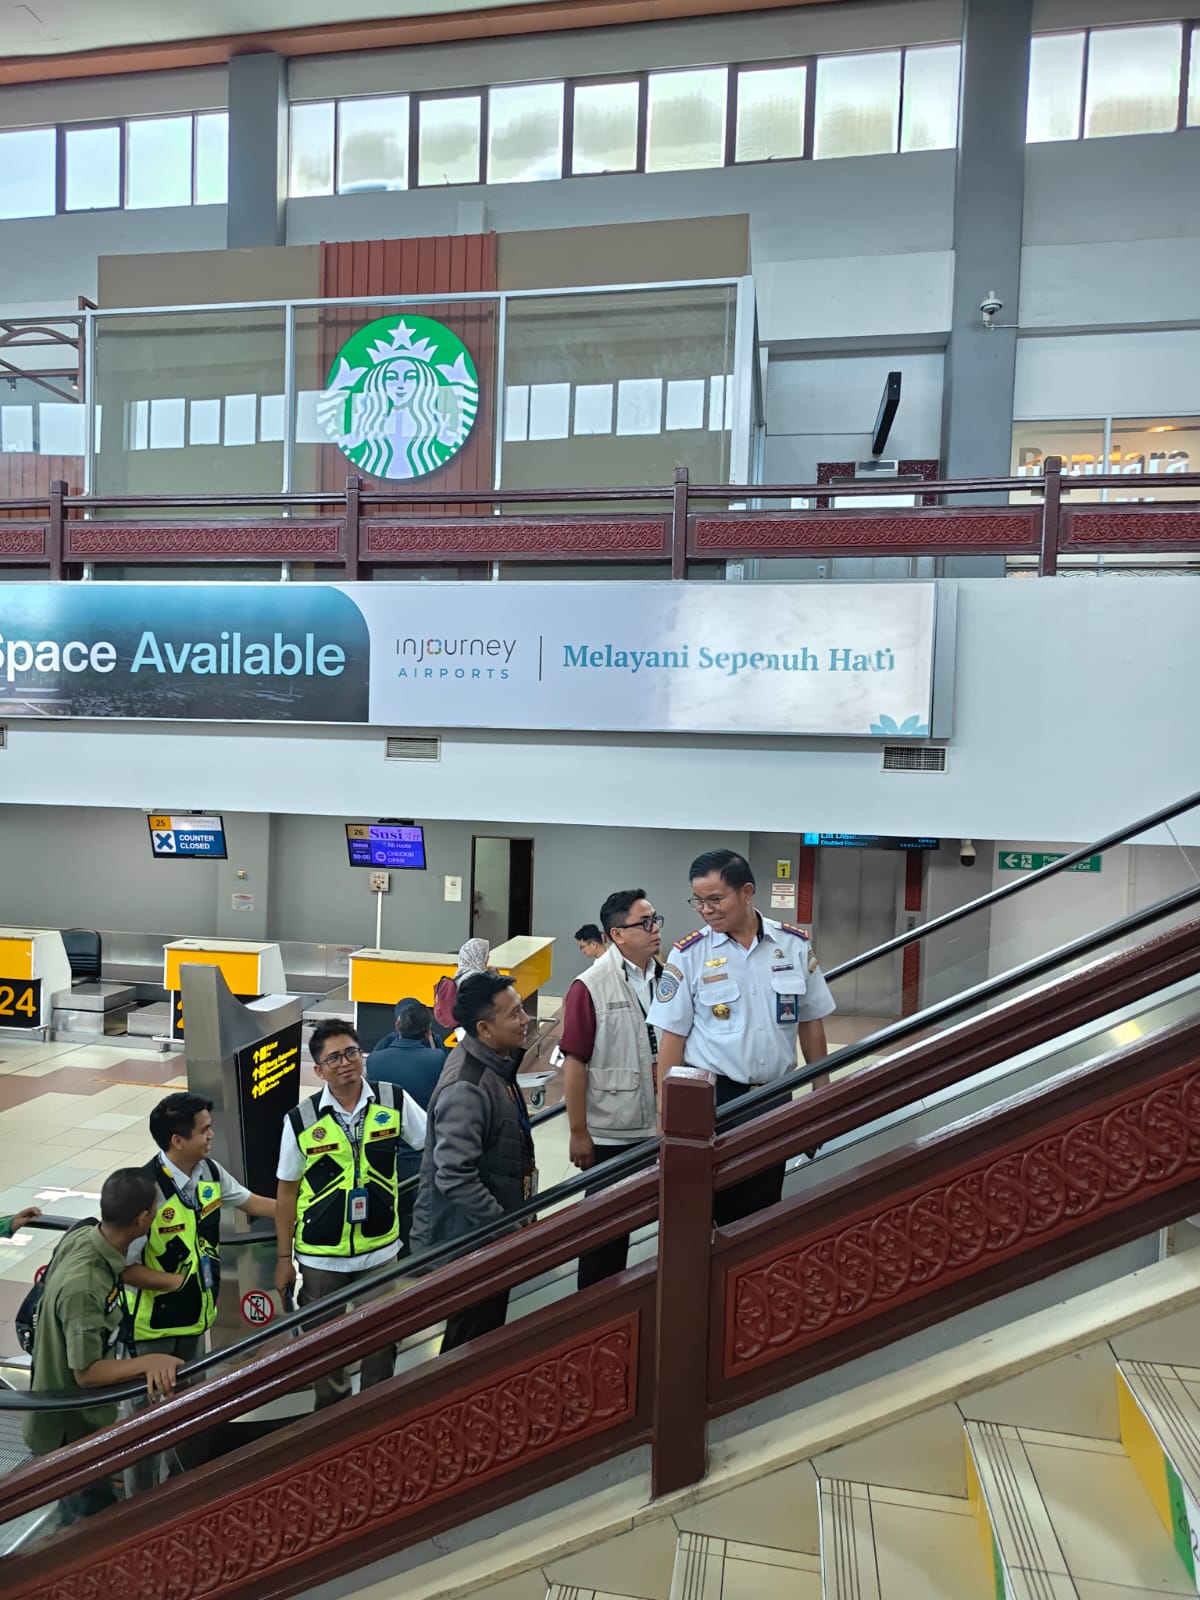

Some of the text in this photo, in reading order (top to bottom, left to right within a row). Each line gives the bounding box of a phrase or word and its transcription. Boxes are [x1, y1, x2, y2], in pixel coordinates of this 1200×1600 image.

[0, 631, 345, 682] pace Available
[562, 644, 895, 676] Melayani Sepenuh Hati
[398, 667, 509, 679] AIRPORTS
[155, 819, 166, 827] 25
[178, 834, 215, 842] COUNTER
[370, 828, 403, 840] Susi
[180, 842, 210, 850] CLOSED
[0, 985, 37, 1018] 24
